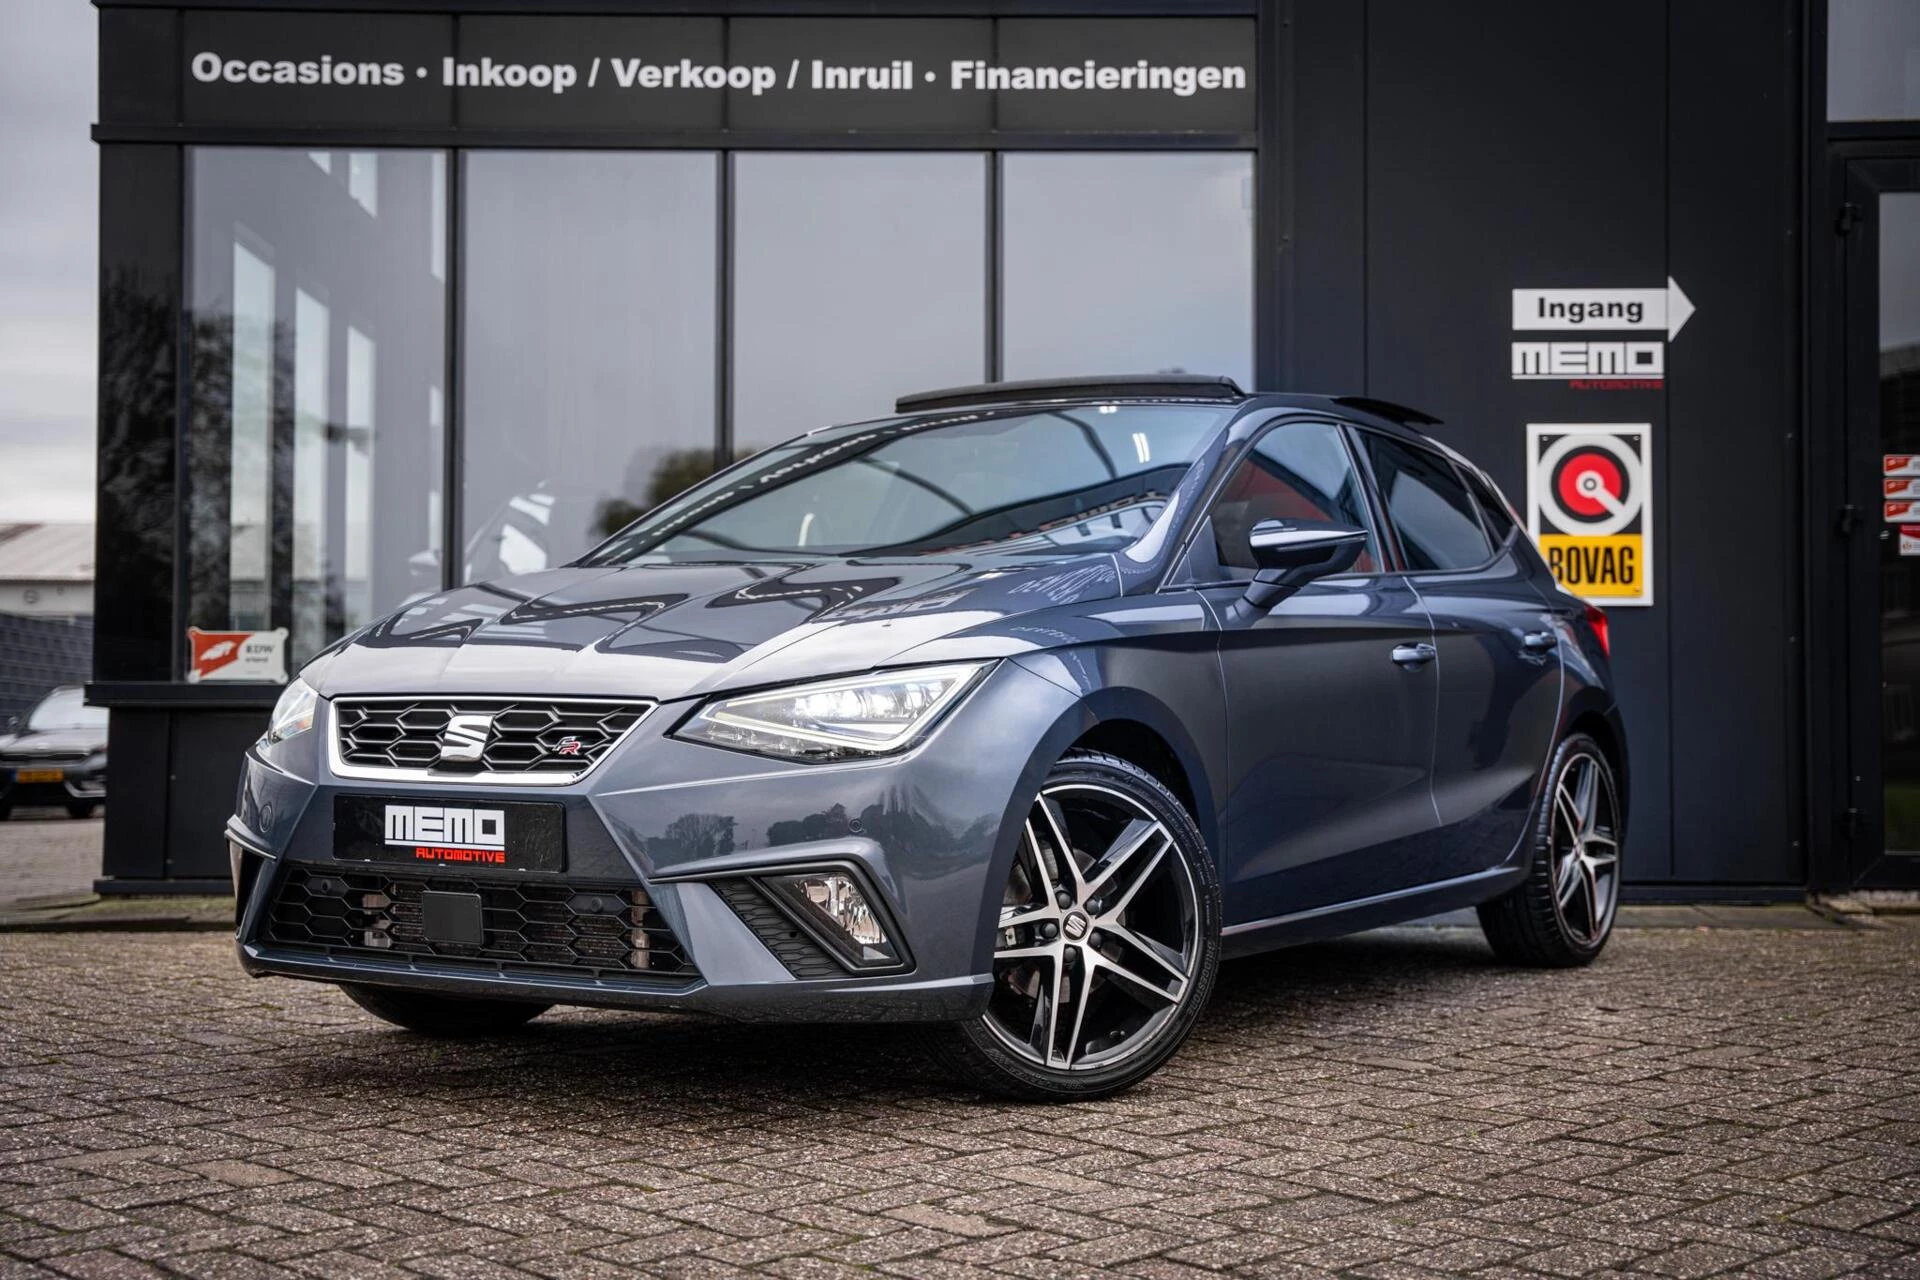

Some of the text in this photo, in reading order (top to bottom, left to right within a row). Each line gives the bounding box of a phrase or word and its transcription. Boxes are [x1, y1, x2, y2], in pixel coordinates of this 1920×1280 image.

[192, 52, 405, 86] Occasions
[443, 57, 577, 94] Inkoop
[610, 58, 777, 96] Verkoop
[811, 60, 913, 90] Inruil
[951, 60, 1246, 97] Financieringen
[1537, 296, 1644, 324] Ingang
[1511, 341, 1665, 378] MEMO
[1549, 545, 1635, 585] BOVAG
[384, 804, 506, 848] MEMO
[415, 847, 506, 864] AUTOMOTIVE
[1186, 939, 1216, 1017] BRIDGESTONE
